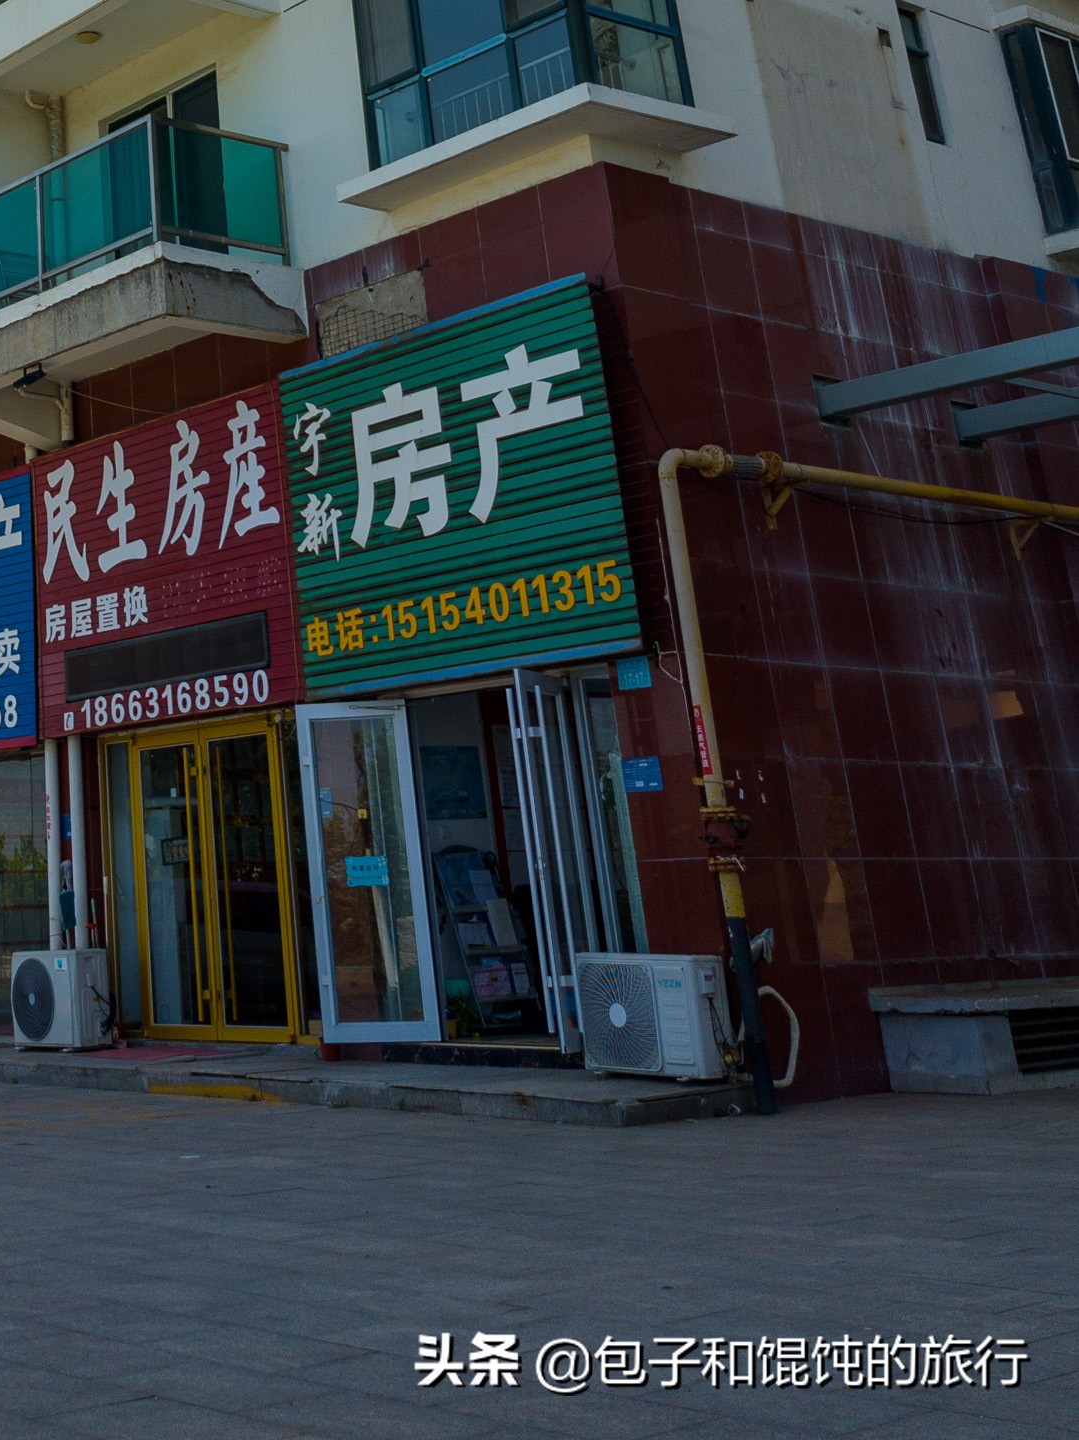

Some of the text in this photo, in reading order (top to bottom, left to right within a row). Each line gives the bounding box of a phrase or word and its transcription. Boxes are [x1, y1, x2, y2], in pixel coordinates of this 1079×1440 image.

[293, 402, 342, 561] 宇新
[351, 344, 584, 549] 房产
[45, 585, 150, 645] 房屋置换
[80, 669, 270, 730] 18663168590
